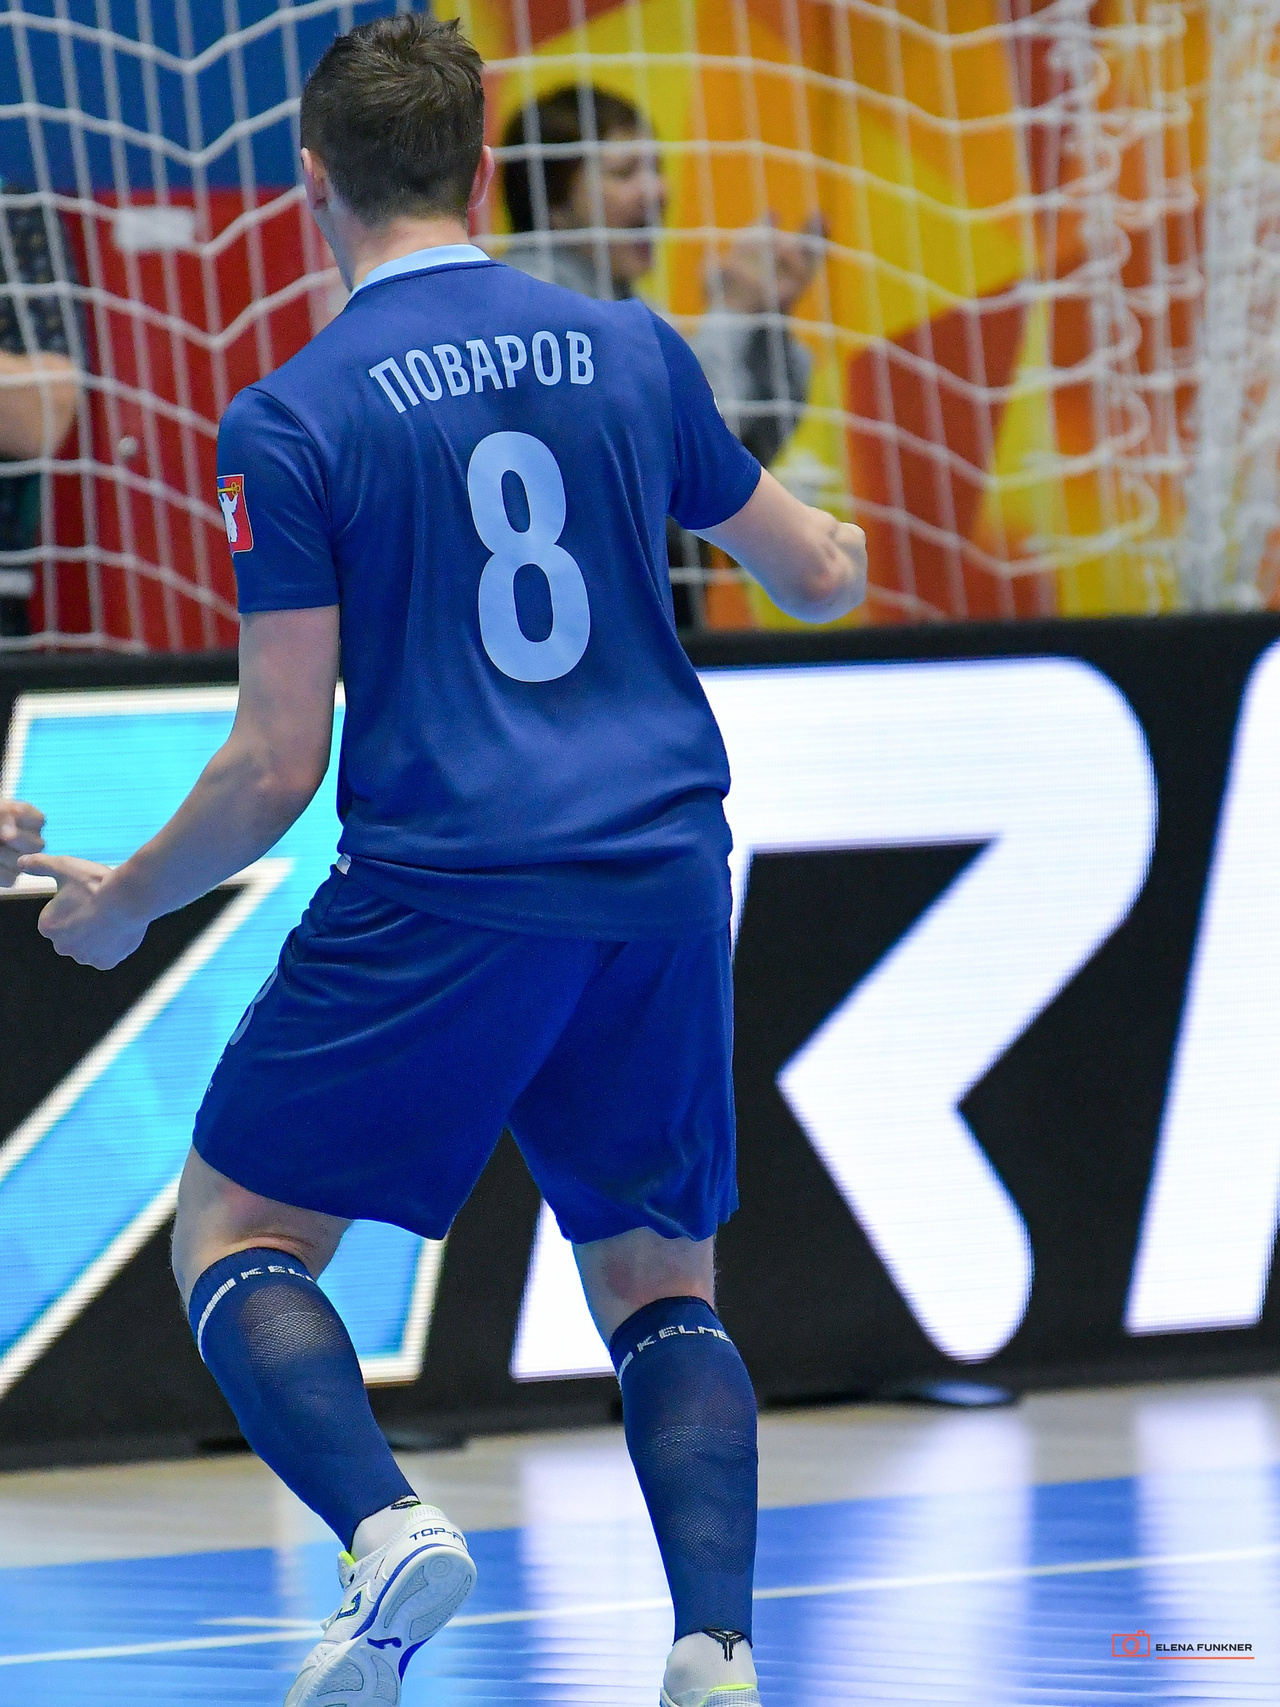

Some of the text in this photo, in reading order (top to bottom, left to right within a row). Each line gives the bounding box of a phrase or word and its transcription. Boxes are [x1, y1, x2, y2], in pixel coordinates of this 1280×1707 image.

[370, 330, 595, 414] ПОВАРОВ
[467, 431, 591, 682] 8
[636, 1324, 734, 1353] KELME
